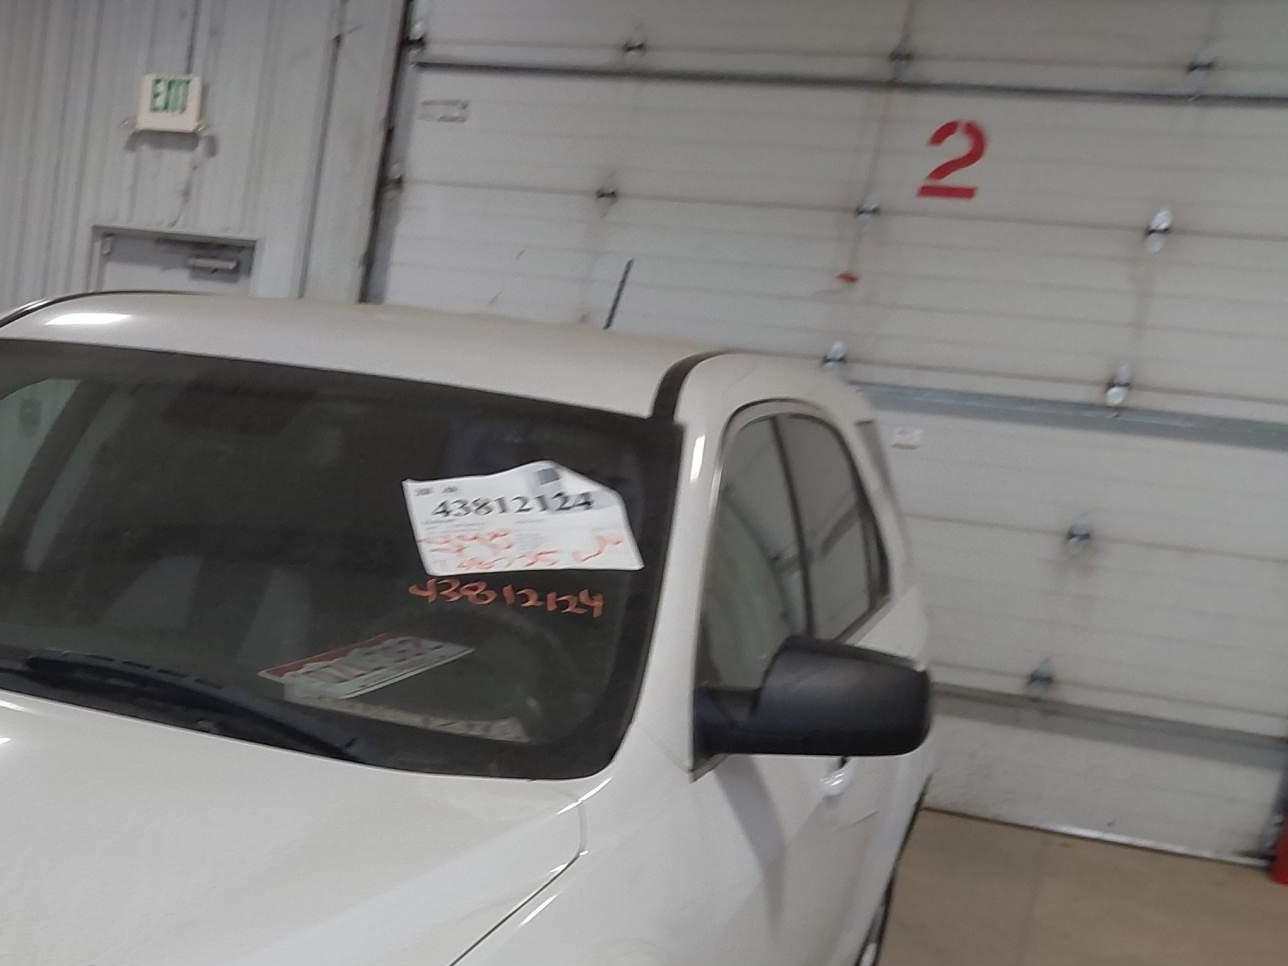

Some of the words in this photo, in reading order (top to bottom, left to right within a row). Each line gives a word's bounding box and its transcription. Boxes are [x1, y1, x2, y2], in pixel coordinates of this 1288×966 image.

[149, 78, 191, 113] EXIT
[918, 120, 986, 199] 2
[431, 491, 595, 518] 43812124
[408, 577, 605, 618] 43812124
